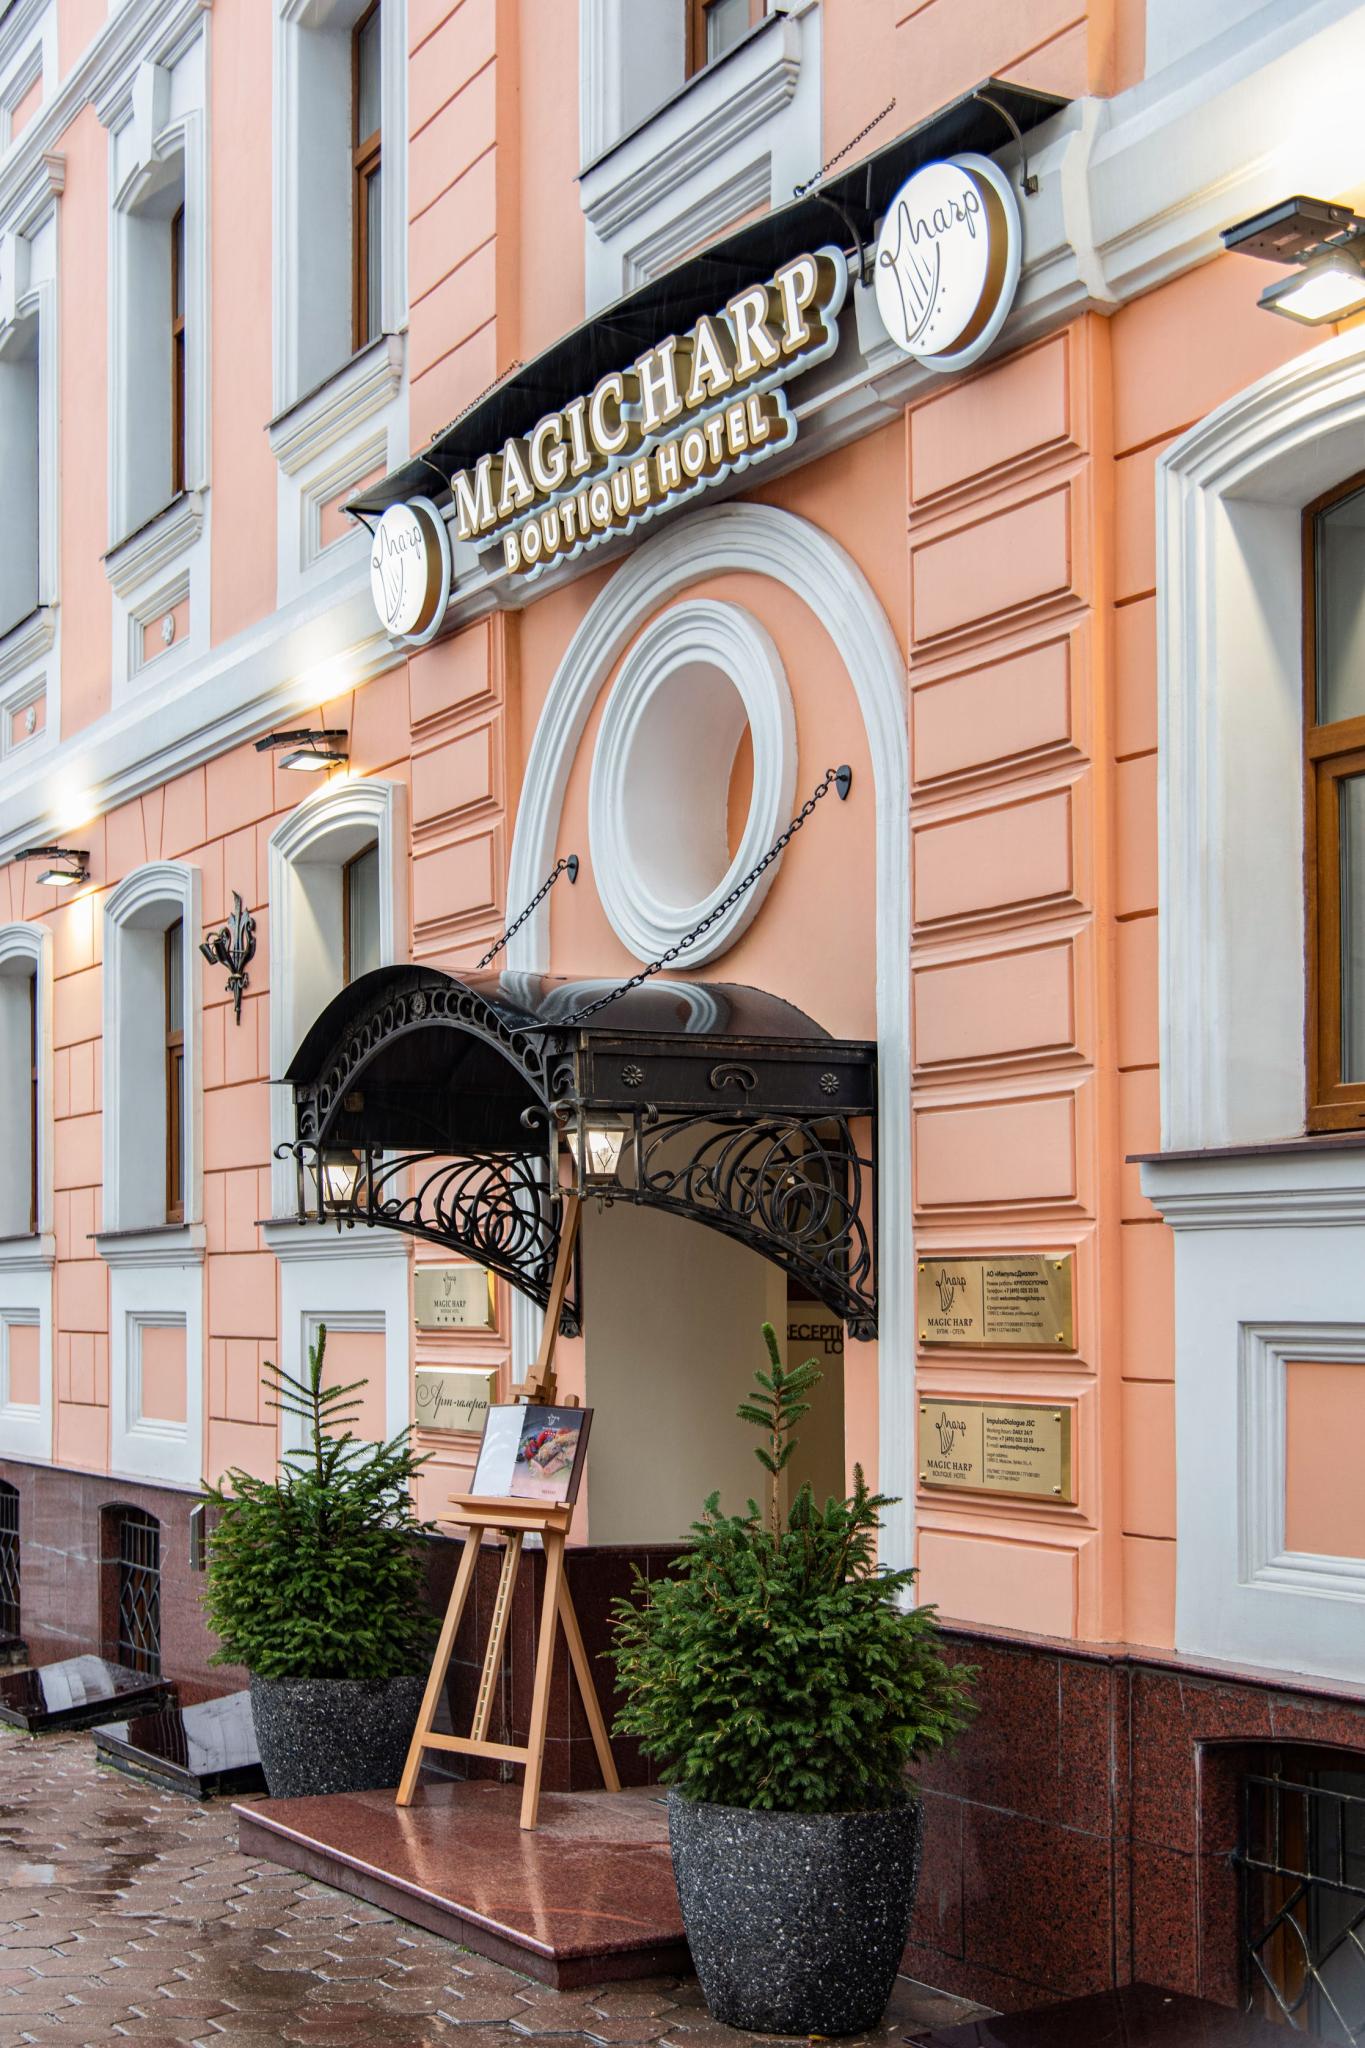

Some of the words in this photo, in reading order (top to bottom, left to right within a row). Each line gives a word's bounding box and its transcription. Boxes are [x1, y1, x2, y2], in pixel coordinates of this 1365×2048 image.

[451, 372, 629, 541] MAGIC
[634, 253, 818, 436] HARP
[503, 456, 650, 574] BOUTIQUE
[656, 394, 770, 493] HOTEL
[927, 1318, 952, 1326] MAGIC
[953, 1318, 973, 1326] HARP
[927, 1459, 952, 1470] MAGIC
[952, 1462, 973, 1471] HARP
